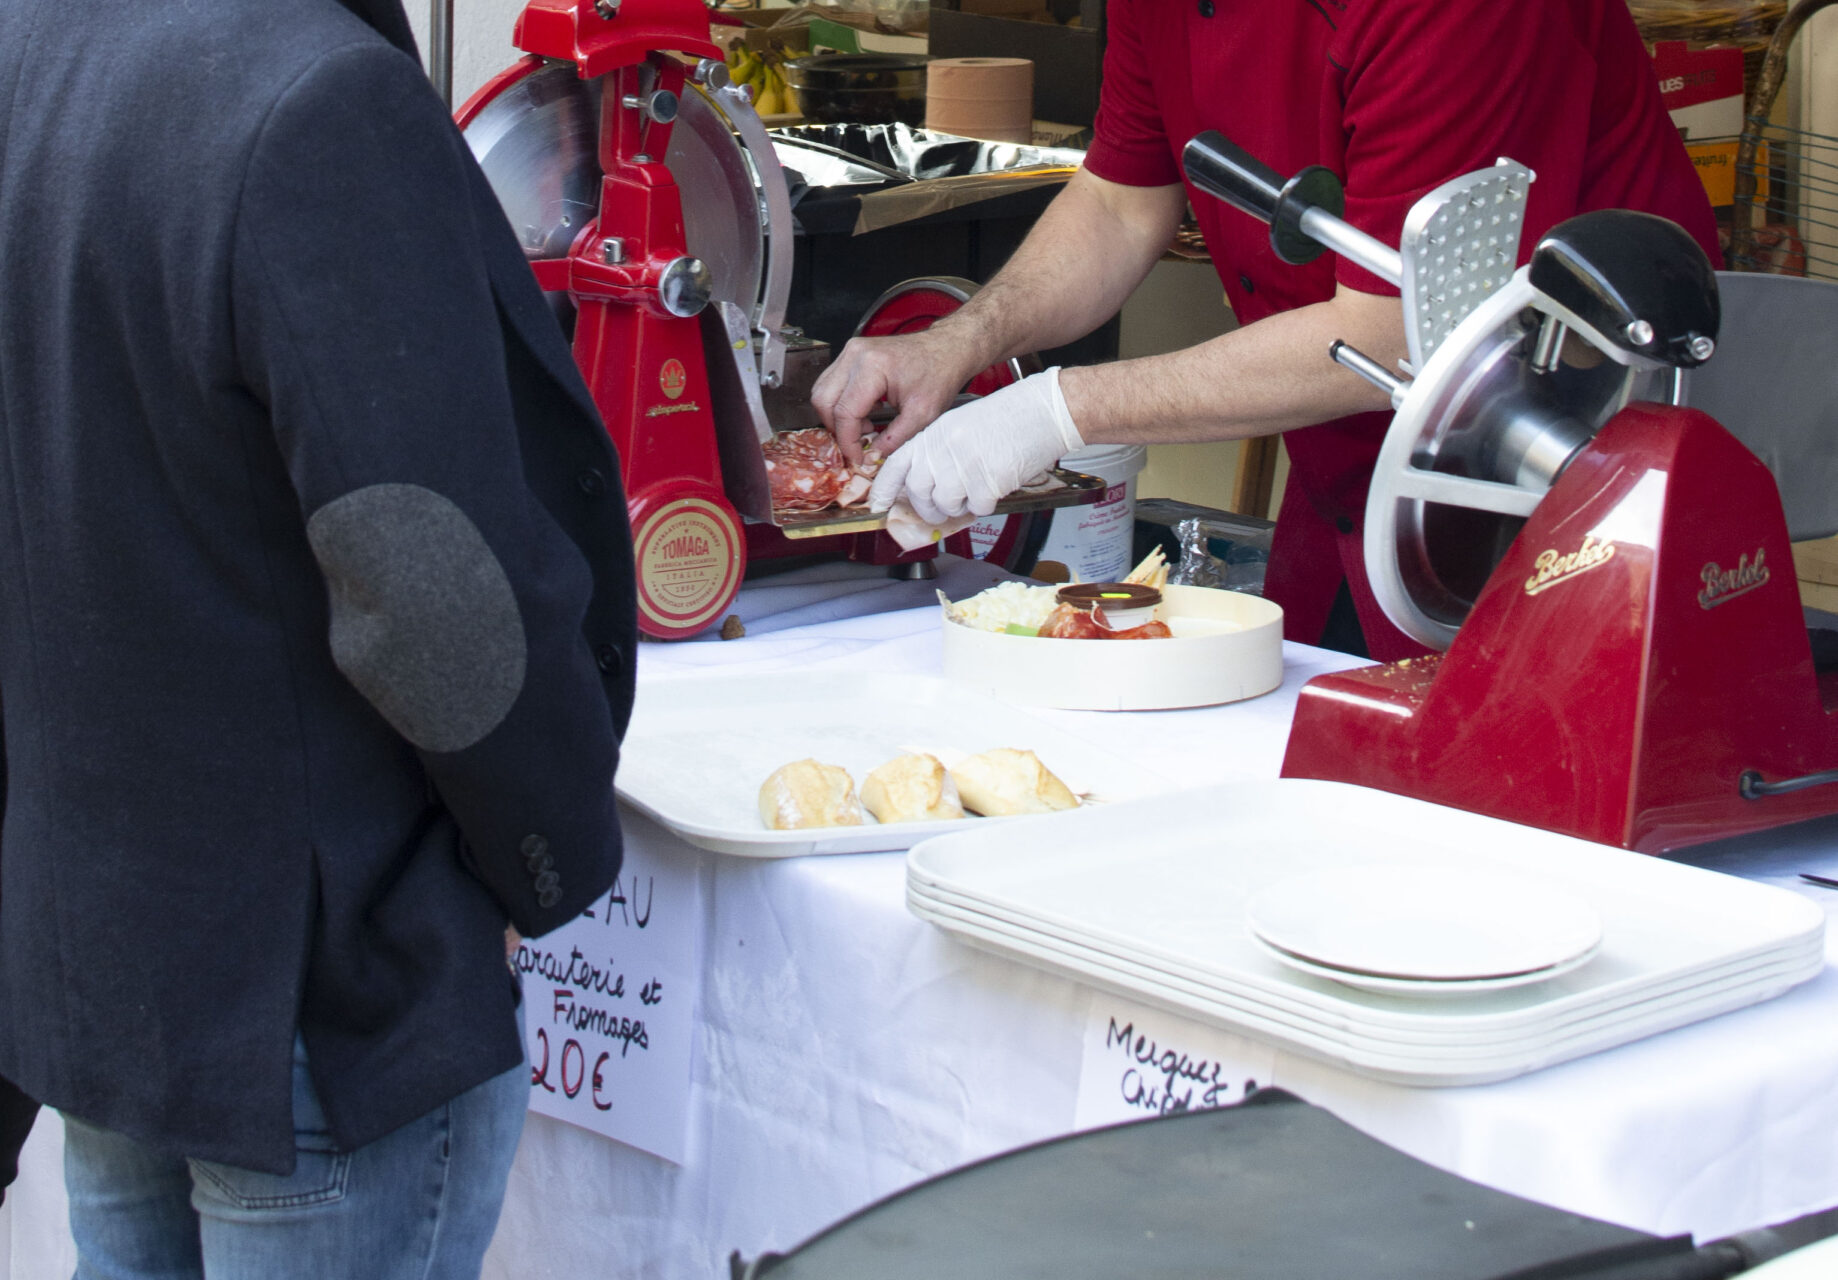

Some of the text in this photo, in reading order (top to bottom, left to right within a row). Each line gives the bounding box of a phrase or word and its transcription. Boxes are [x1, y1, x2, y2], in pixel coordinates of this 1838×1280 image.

[1658, 76, 1685, 94] ues
[661, 536, 710, 560] TOMAGA
[969, 522, 1001, 537] aîche
[666, 571, 705, 581] ITALIA
[1525, 536, 1616, 596] Berkel
[1698, 548, 1770, 610] Berkel
[583, 875, 653, 929] AU
[516, 943, 662, 1005] arcuterie et
[554, 990, 648, 1058] Fromages
[531, 1027, 612, 1111] 20€
